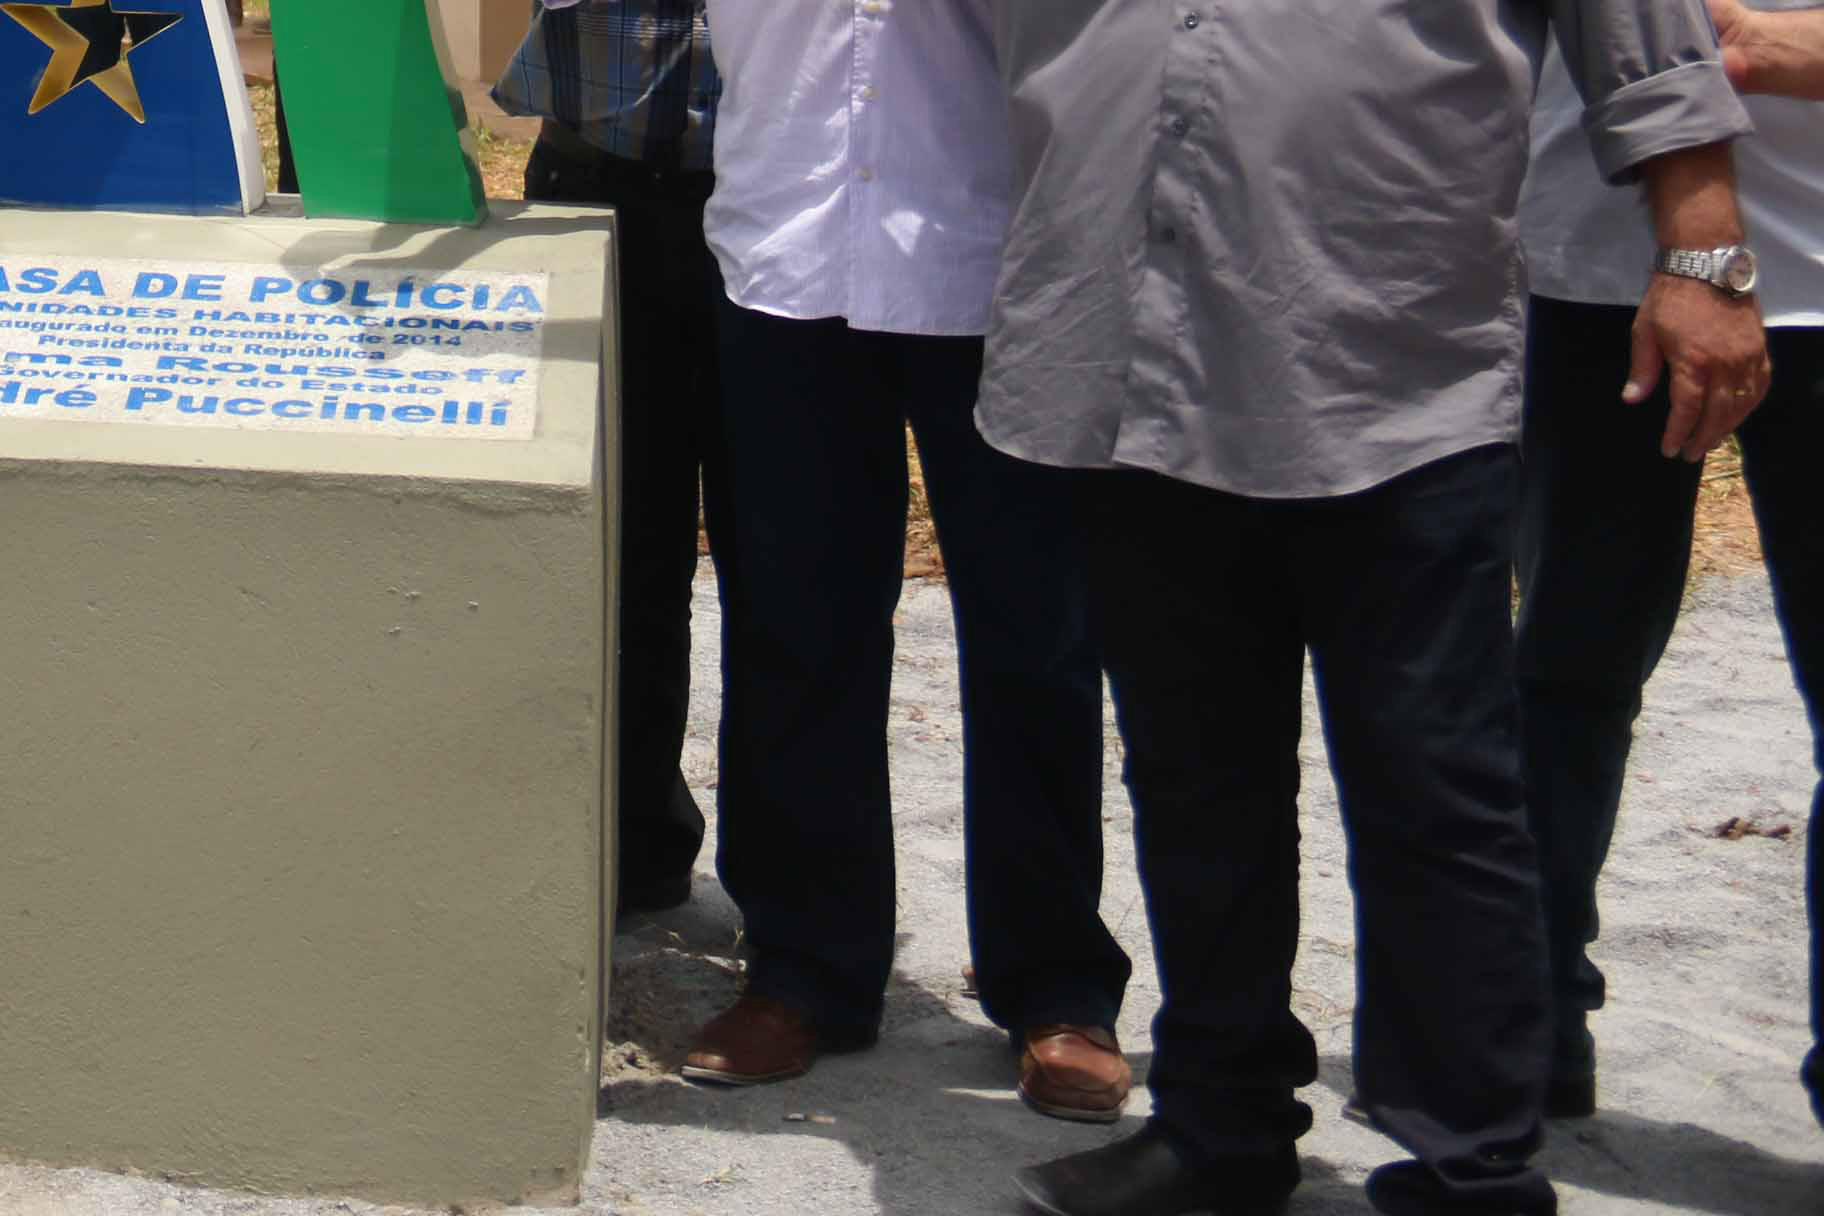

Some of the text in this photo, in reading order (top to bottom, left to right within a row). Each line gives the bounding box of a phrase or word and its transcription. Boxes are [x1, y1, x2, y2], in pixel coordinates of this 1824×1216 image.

[132, 271, 226, 302] DE
[249, 275, 543, 313] POLÍCIA
[193, 309, 535, 332] HABITACIONAIS
[38, 335, 190, 353] Presidenta
[199, 342, 234, 354] da
[136, 325, 179, 335] em
[189, 325, 329, 342] Dezembro
[348, 333, 384, 345] de
[392, 333, 463, 347] 2014
[156, 355, 528, 385] Rousseff
[236, 376, 286, 389] do
[300, 378, 444, 396] Estado
[125, 386, 513, 427] Puccinelli
